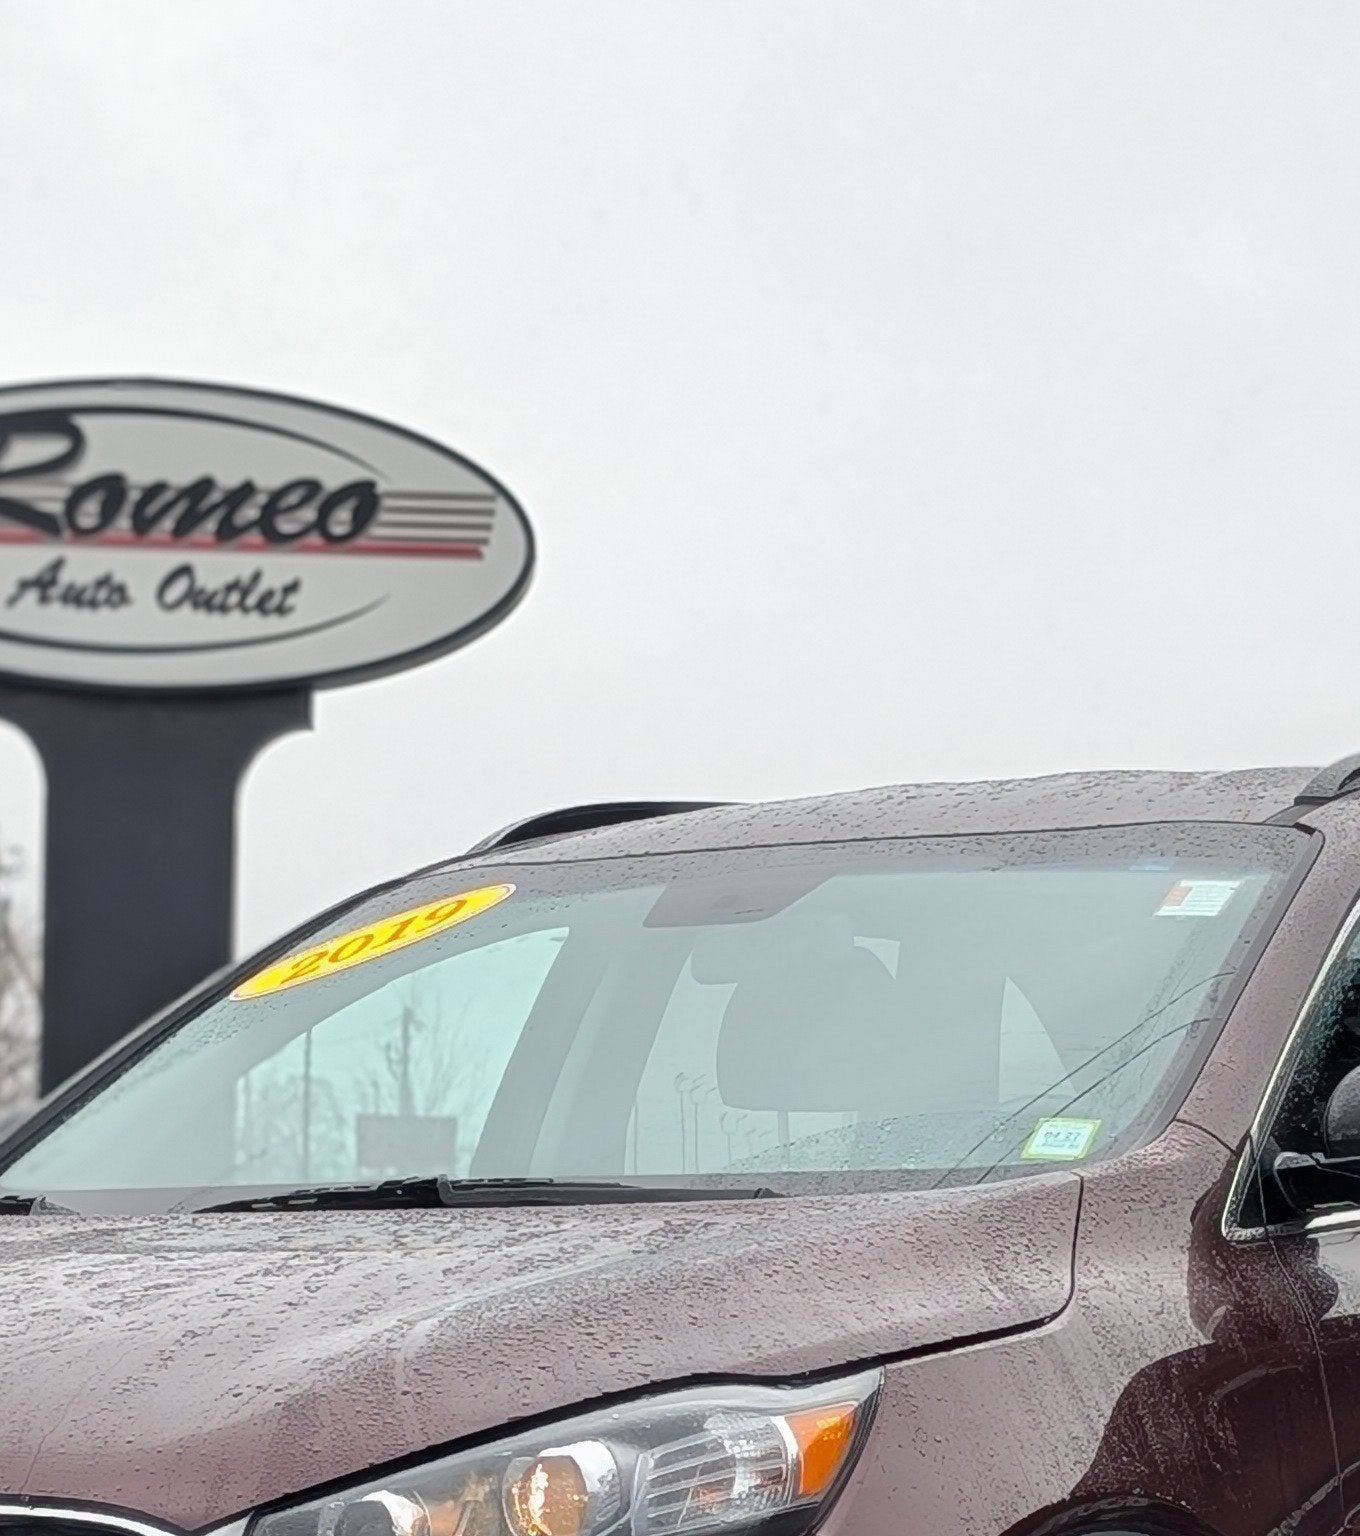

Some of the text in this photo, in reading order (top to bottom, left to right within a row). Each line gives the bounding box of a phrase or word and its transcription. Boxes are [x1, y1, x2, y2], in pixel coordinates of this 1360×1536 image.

[5, 557, 302, 618] Auto Outlet
[280, 898, 469, 986] 2019
